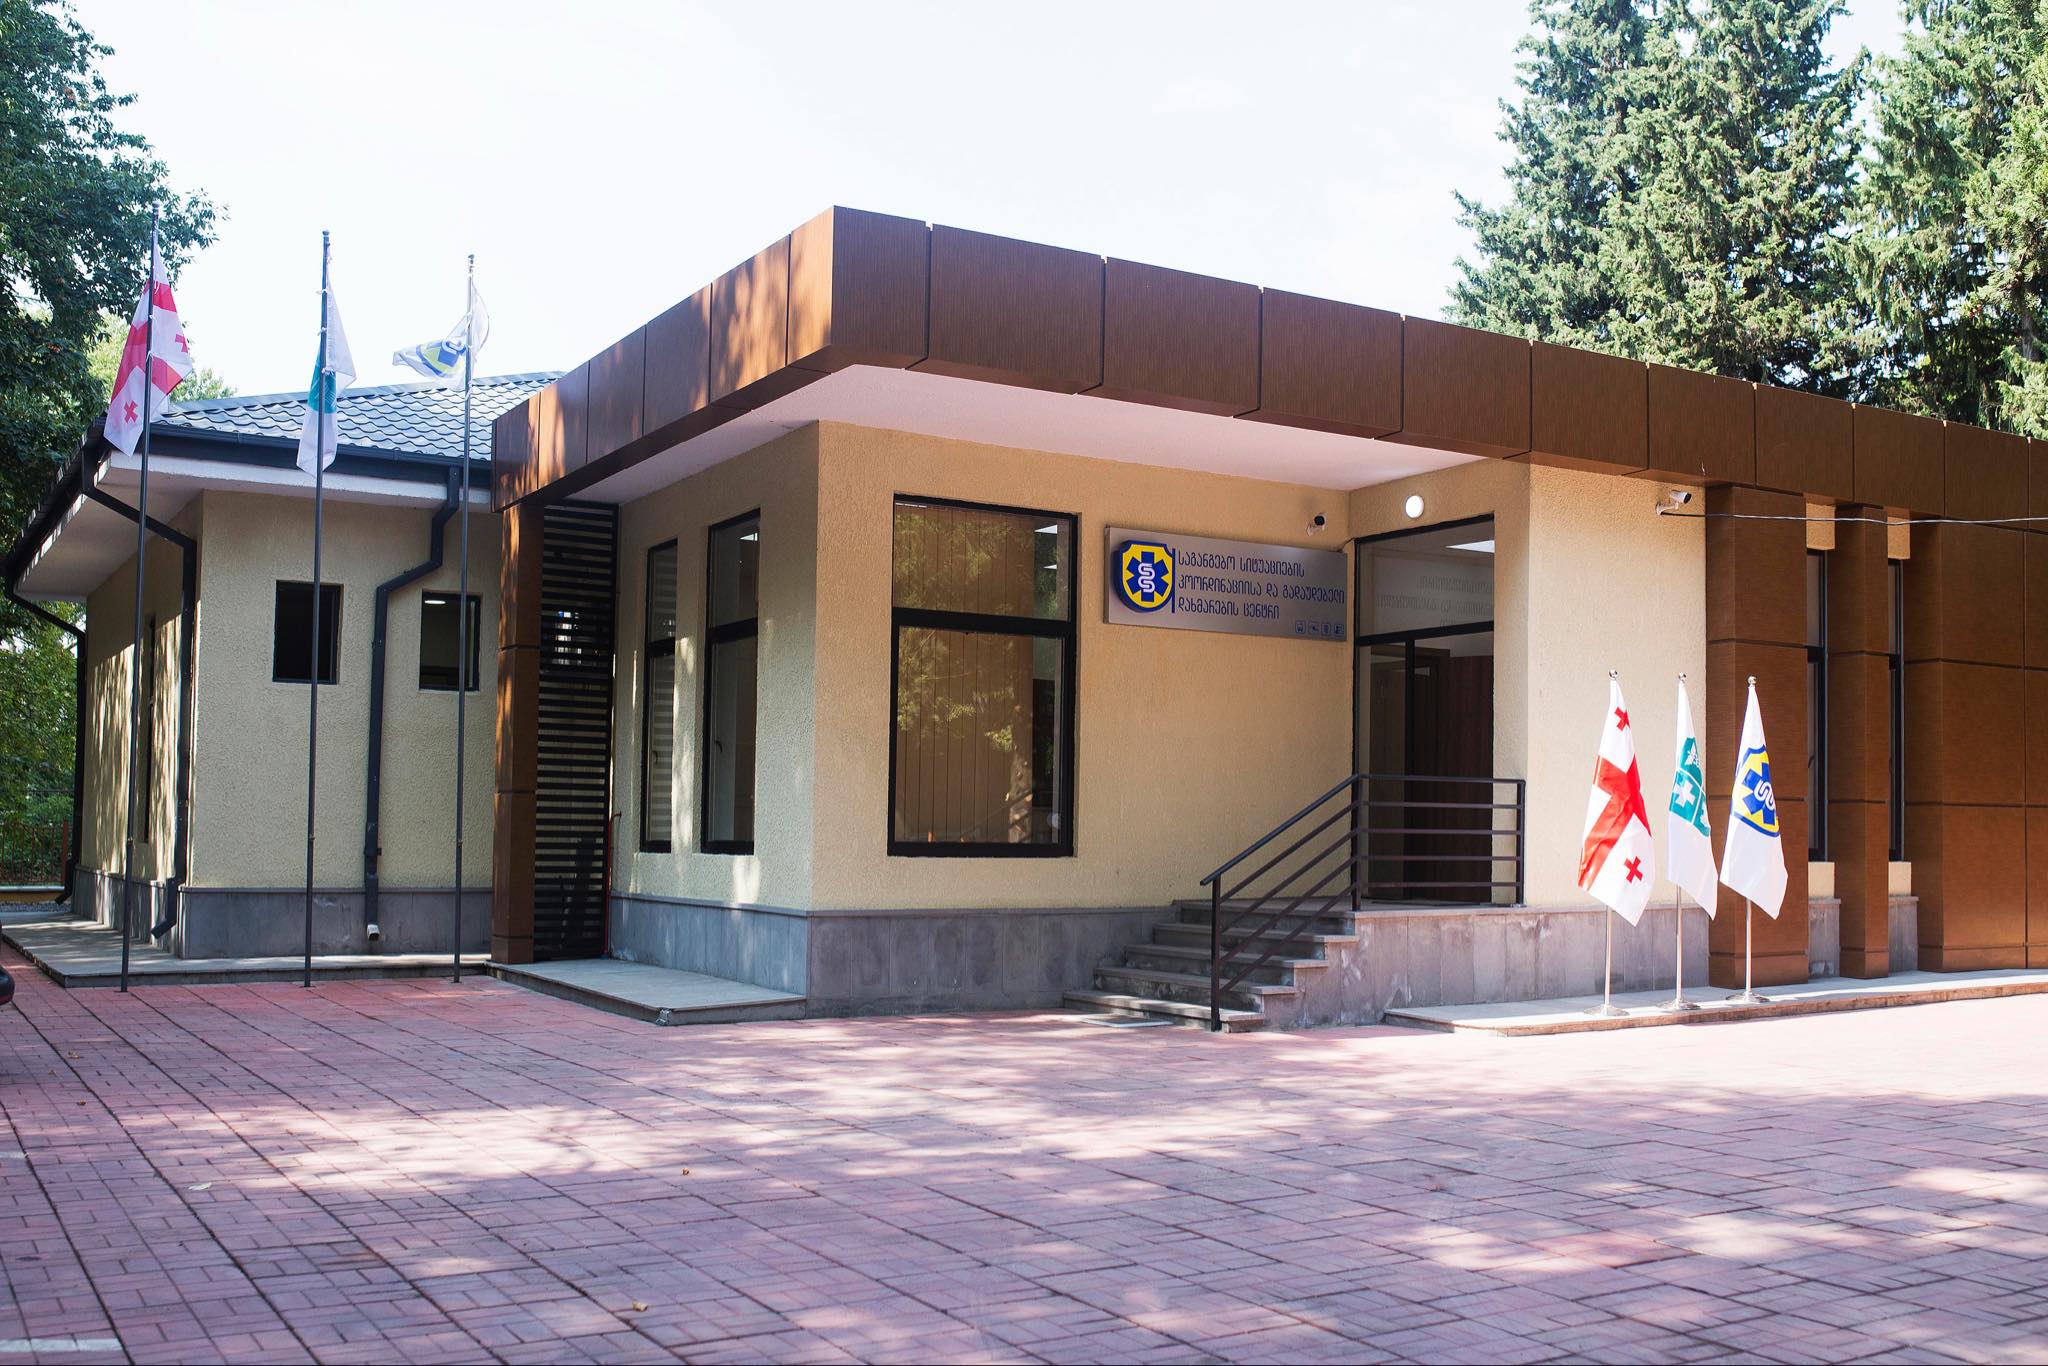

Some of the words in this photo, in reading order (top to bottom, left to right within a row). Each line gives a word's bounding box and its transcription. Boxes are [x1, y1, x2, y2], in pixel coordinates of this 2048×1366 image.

[1178, 550, 1236, 570] საგანგებო
[1240, 557, 1305, 578] სიტუაციების
[1178, 574, 1262, 596] კოორდინაციისა
[1266, 583, 1279, 598] და
[1282, 585, 1345, 604] გადაუდებელი
[1178, 596, 1239, 616] დახმარების
[1243, 602, 1280, 619] ცენტრი
